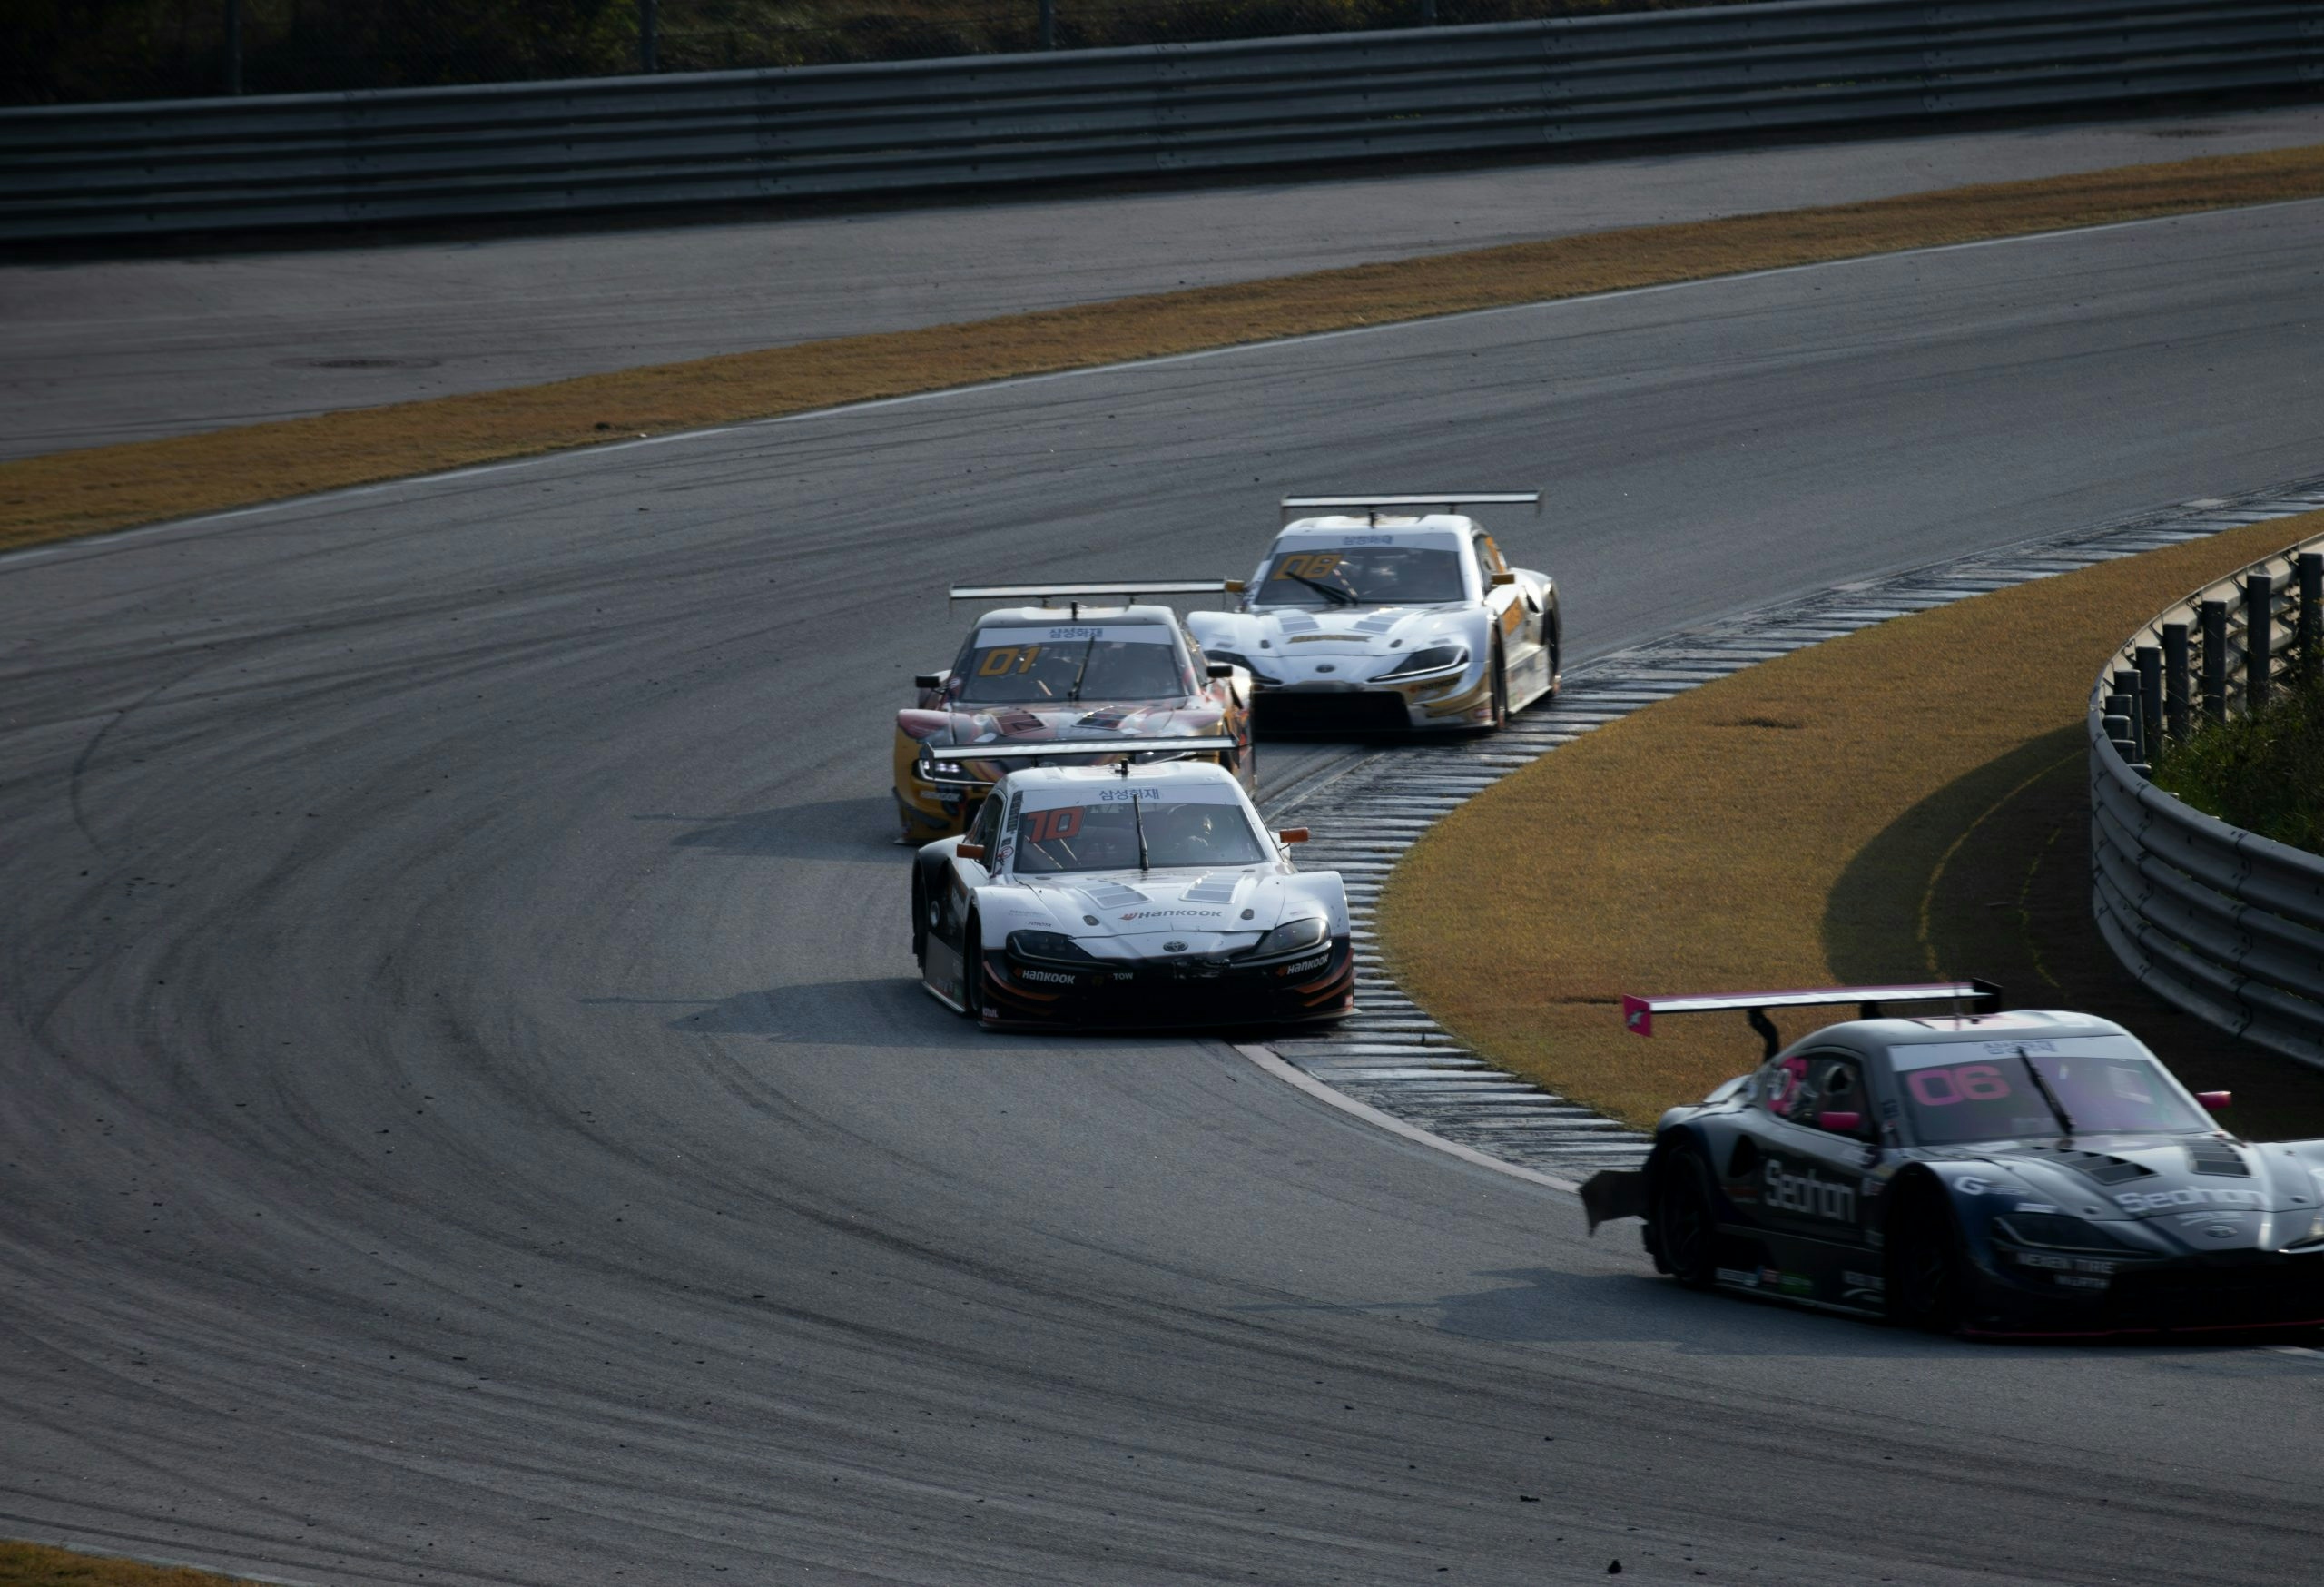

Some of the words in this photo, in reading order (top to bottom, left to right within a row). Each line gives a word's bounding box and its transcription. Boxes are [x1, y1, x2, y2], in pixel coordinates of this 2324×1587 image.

[1272, 552, 1344, 581] 08
[977, 646, 1043, 677] 01
[1026, 805, 1085, 843] 10
[1113, 971, 1134, 981] TOW
[1907, 1065, 2012, 1107] 06
